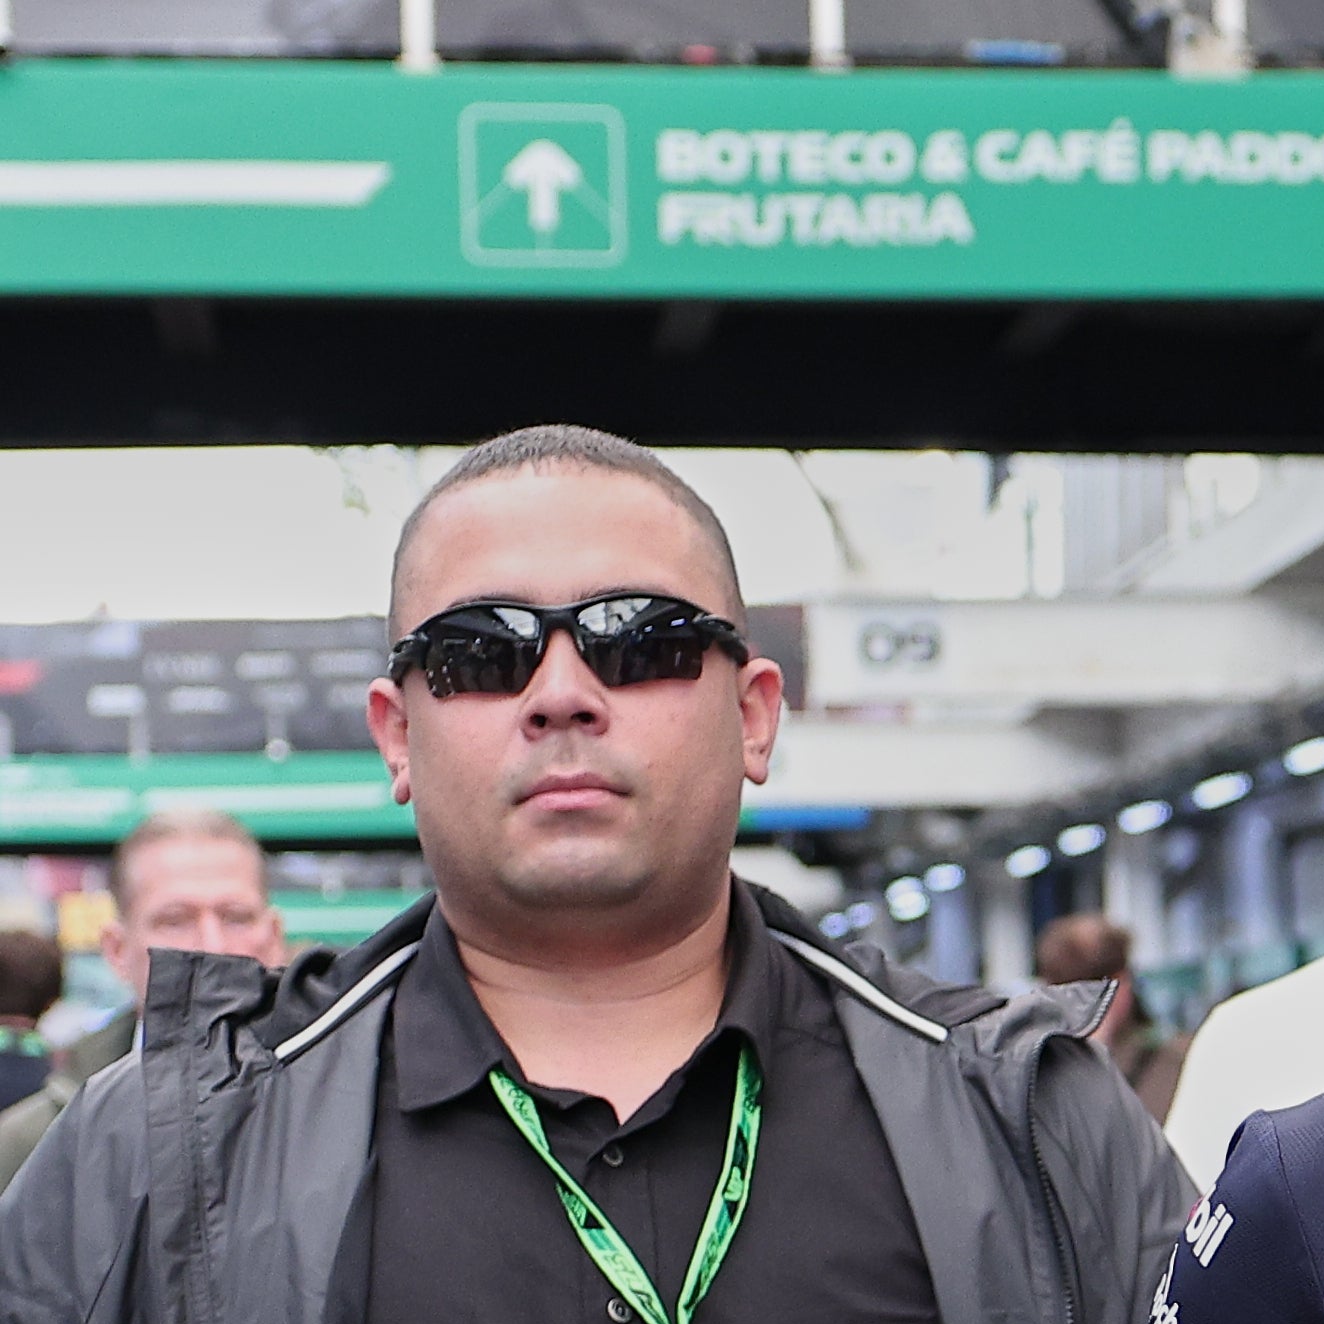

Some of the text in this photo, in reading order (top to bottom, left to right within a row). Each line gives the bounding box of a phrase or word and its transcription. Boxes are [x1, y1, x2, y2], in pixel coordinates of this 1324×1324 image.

[656, 129, 918, 184] BOTECO
[921, 129, 968, 184] &
[974, 117, 1141, 184] CAFÉ
[657, 191, 975, 246] FRUTARIA
[1185, 1183, 1234, 1268] bil
